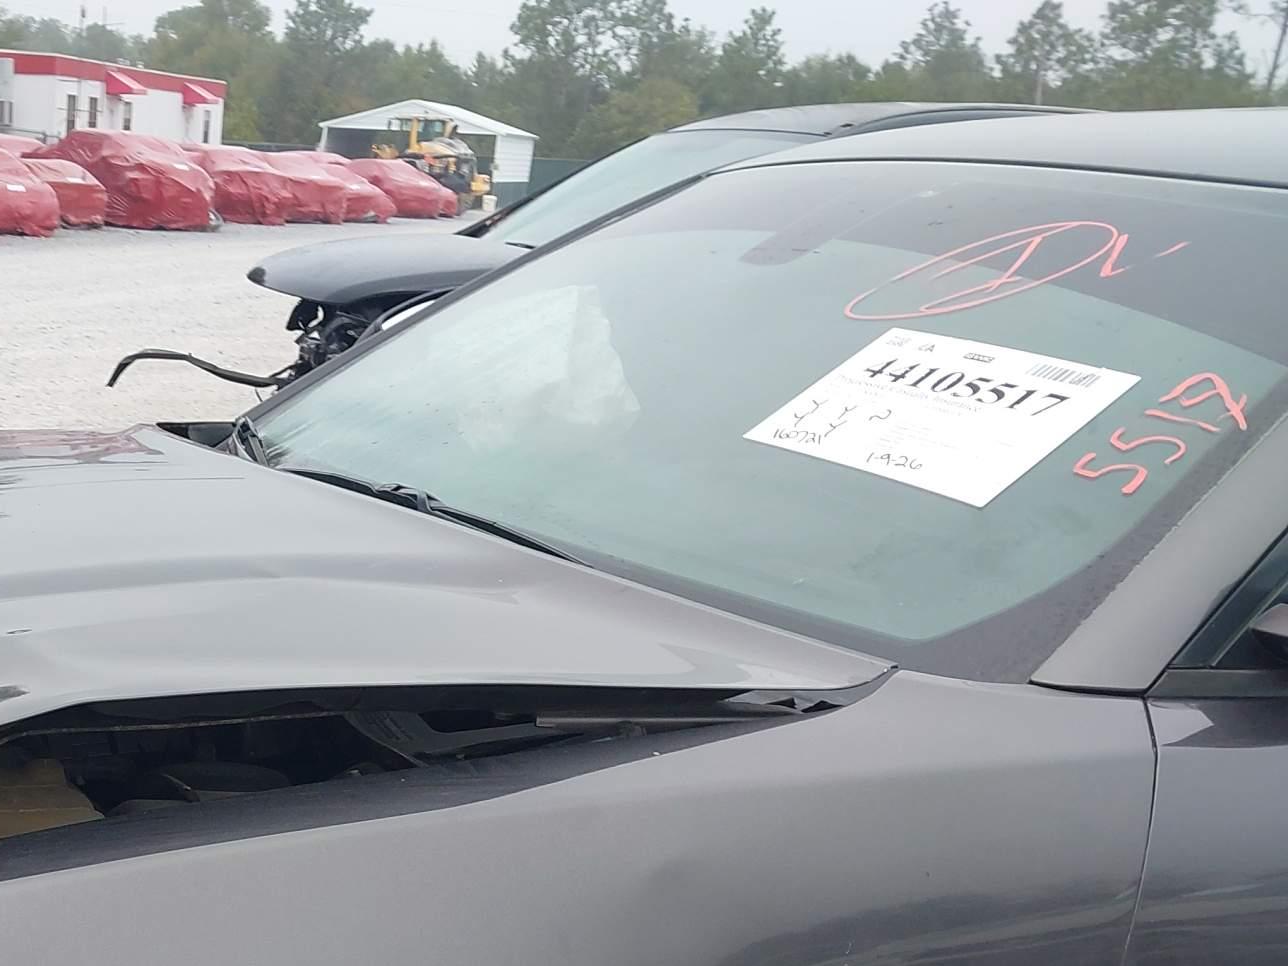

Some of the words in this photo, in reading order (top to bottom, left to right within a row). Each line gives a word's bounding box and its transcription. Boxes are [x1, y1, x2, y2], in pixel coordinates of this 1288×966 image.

[864, 358, 1071, 417] 44105517
[865, 451, 924, 470] 1-9-26
[1073, 371, 1248, 496] 5517
